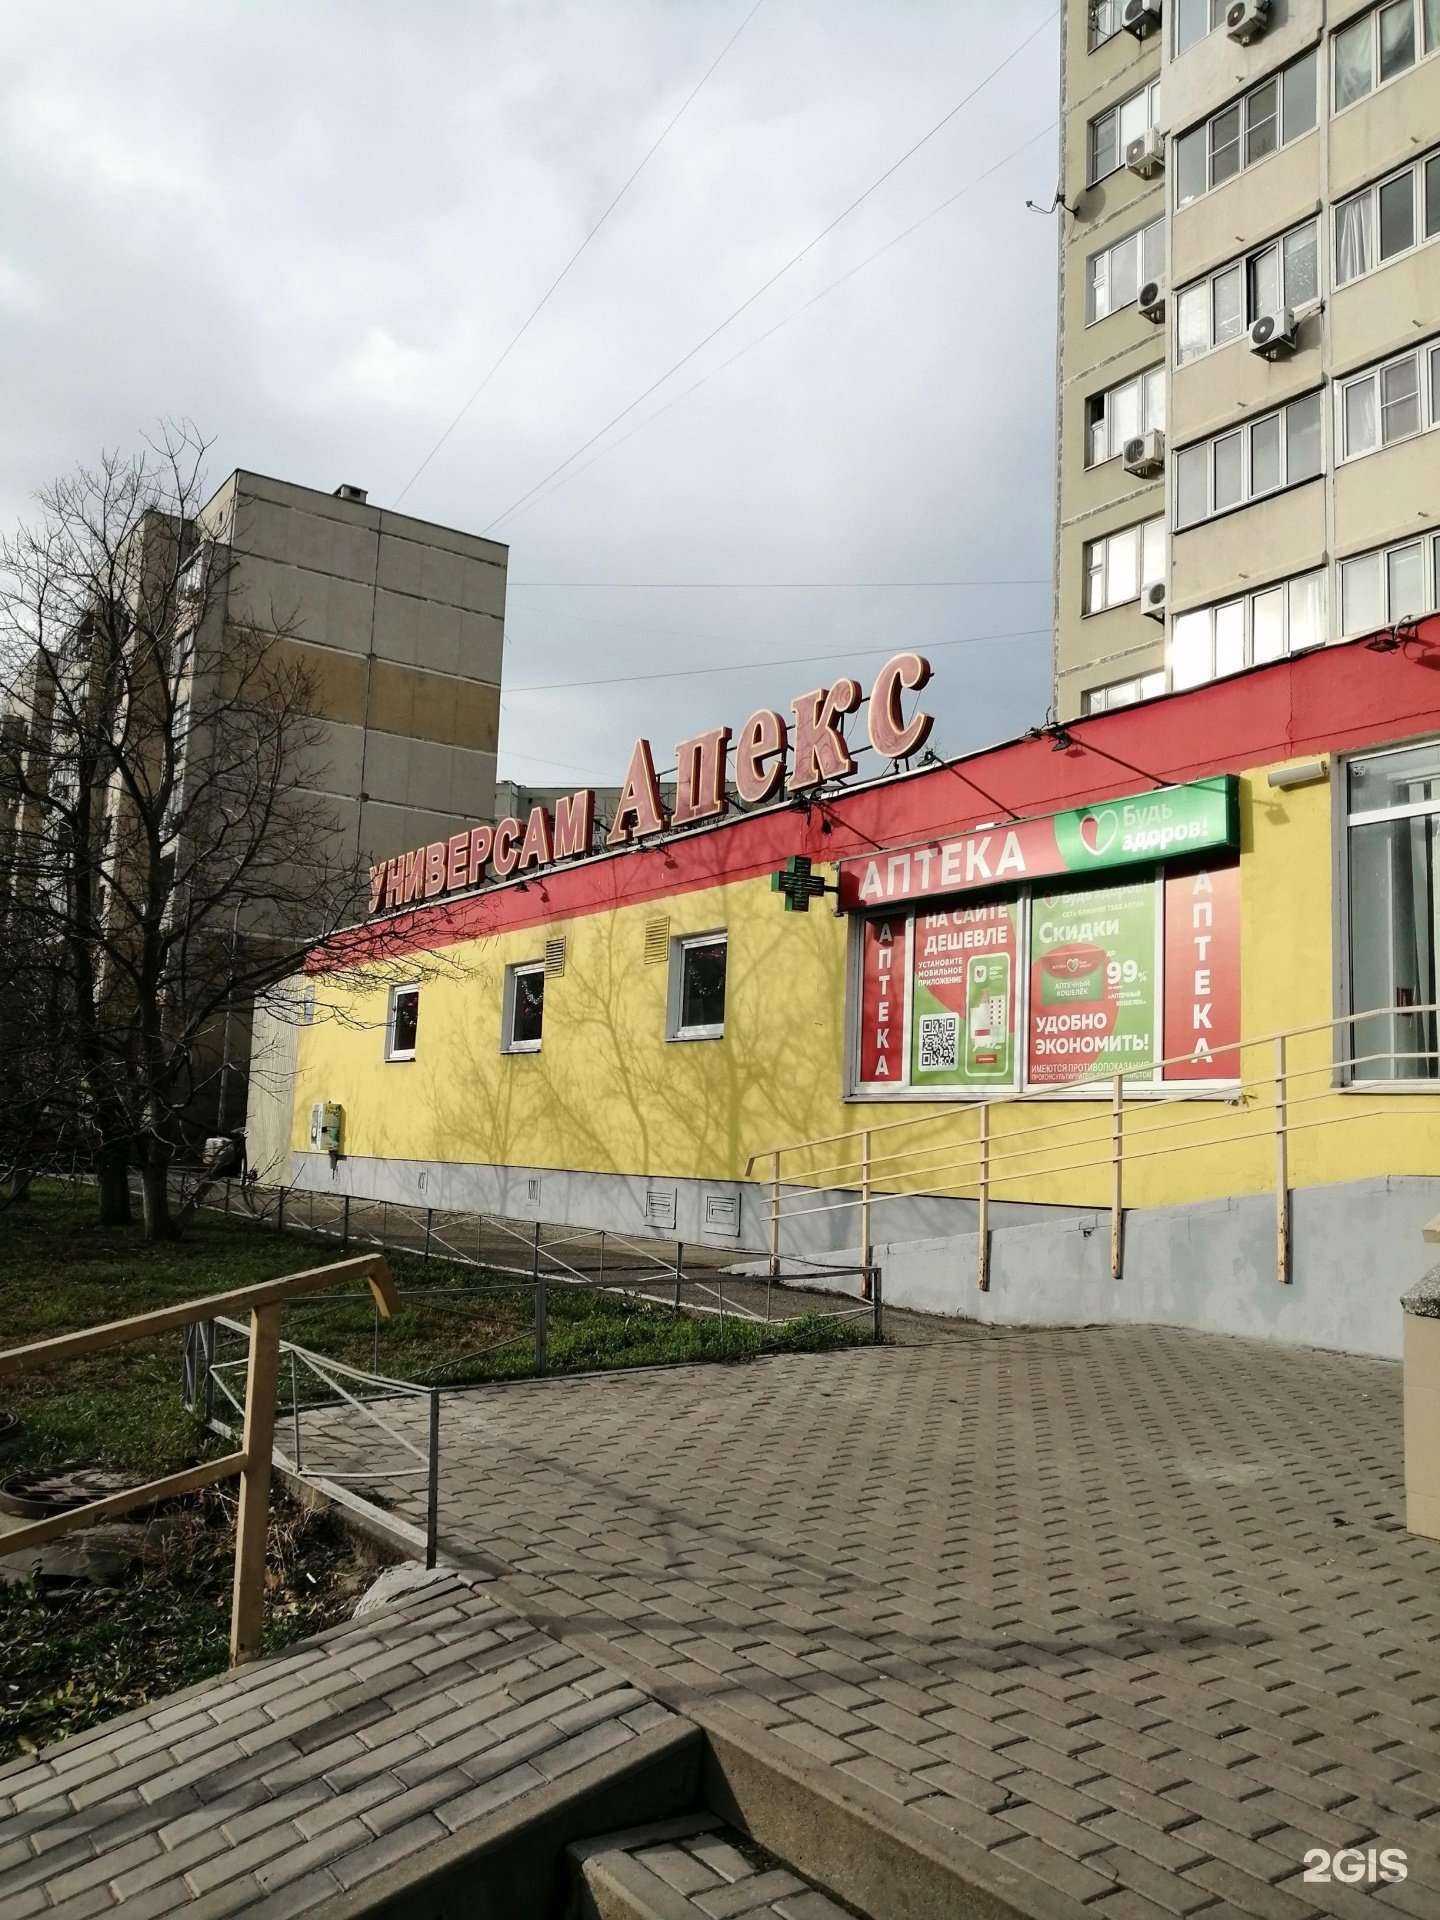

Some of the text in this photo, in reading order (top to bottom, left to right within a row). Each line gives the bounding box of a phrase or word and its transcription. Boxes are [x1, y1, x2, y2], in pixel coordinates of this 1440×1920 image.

[1122, 804, 1173, 827] Будь
[1122, 816, 1208, 852] здоров!
[369, 790, 595, 914] УНИВЕРСАМ
[858, 830, 1026, 901] АПТЕКА
[926, 911, 948, 928] НА
[1039, 919, 1120, 943] Скидки
[924, 926, 1008, 956] ДЕШЕВЛЕ
[918, 957, 963, 969] УСТАНОВИТЕ
[918, 966, 963, 978] МОБИЛЬНОЕ
[1191, 871, 1214, 1063] АПТЕКА
[918, 976, 963, 987] ПРИЛОЖЕНИЕ
[875, 922, 894, 1076] АПТЕКА
[1036, 1012, 1107, 1034] УДОБНО
[1035, 1033, 1149, 1055] ЭКОНОМИТЬ!
[1031, 1063, 1068, 1073] ИМЕЮТСЯ
